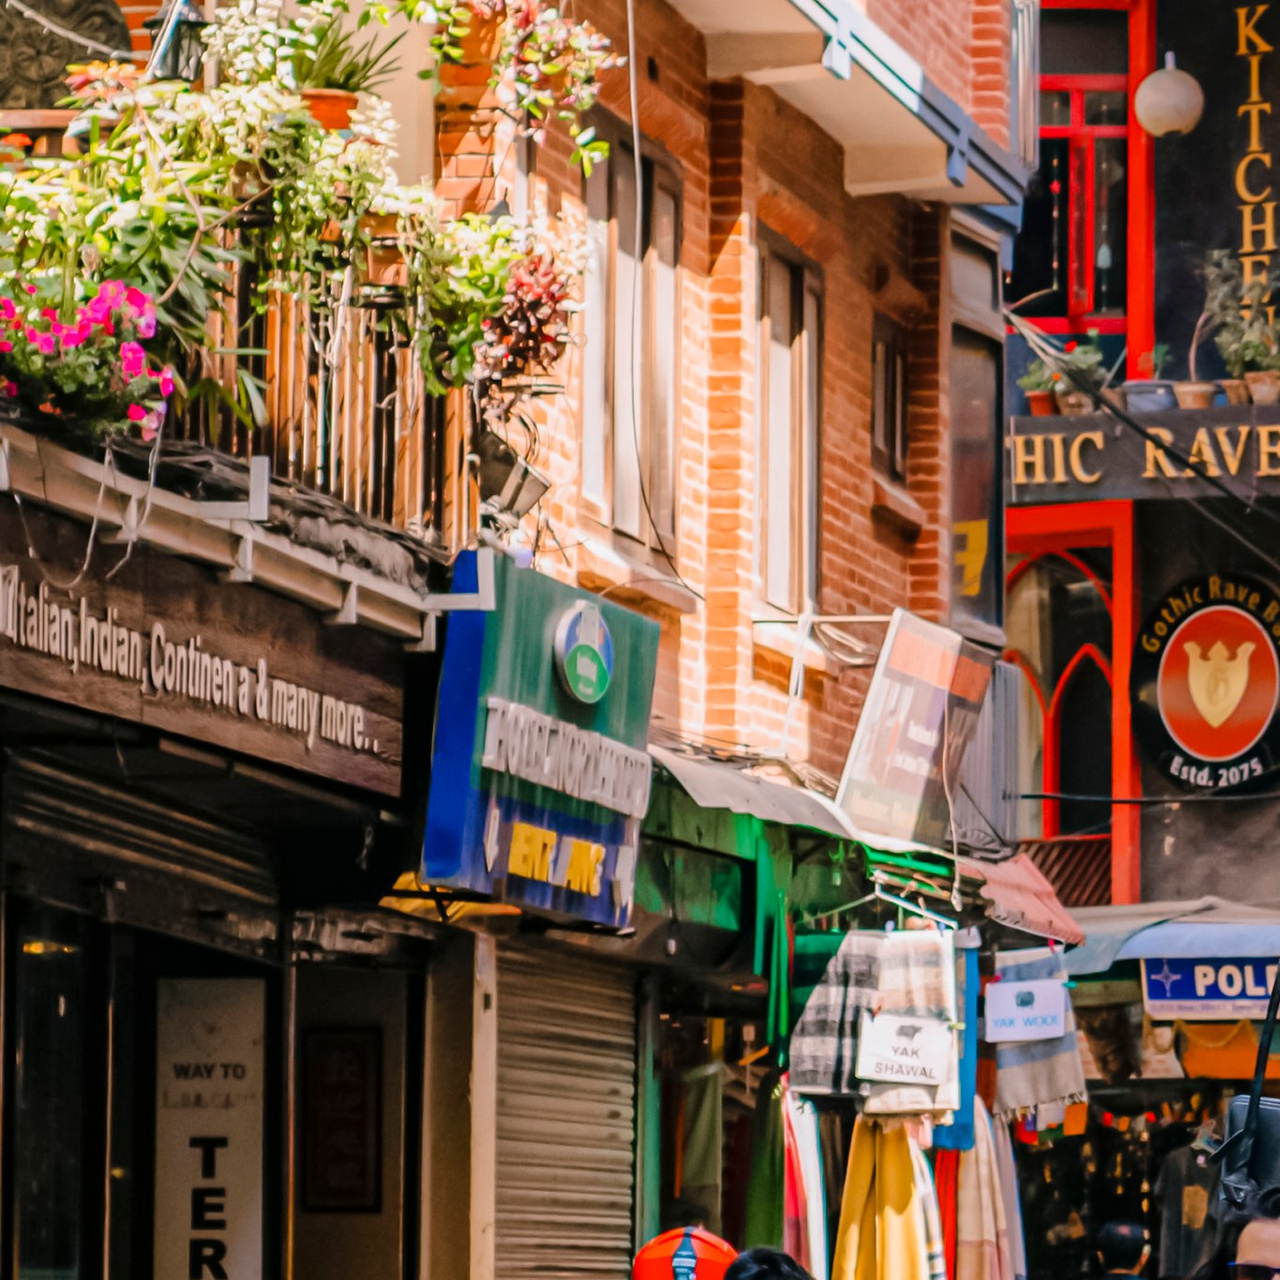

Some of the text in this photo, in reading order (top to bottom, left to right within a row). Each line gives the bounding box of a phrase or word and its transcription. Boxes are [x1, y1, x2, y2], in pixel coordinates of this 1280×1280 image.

[1004, 430, 1105, 486] HIC
[1141, 586, 1204, 653] Gothic
[1208, 575, 1261, 609] Rave
[256, 657, 268, 720] &
[272, 679, 319, 750] many
[1169, 755, 1264, 787] Estd. 2075
[890, 1045, 920, 1060] YAK
[172, 1062, 246, 1080] WAY TO
[874, 1062, 936, 1080] SHAWAL
